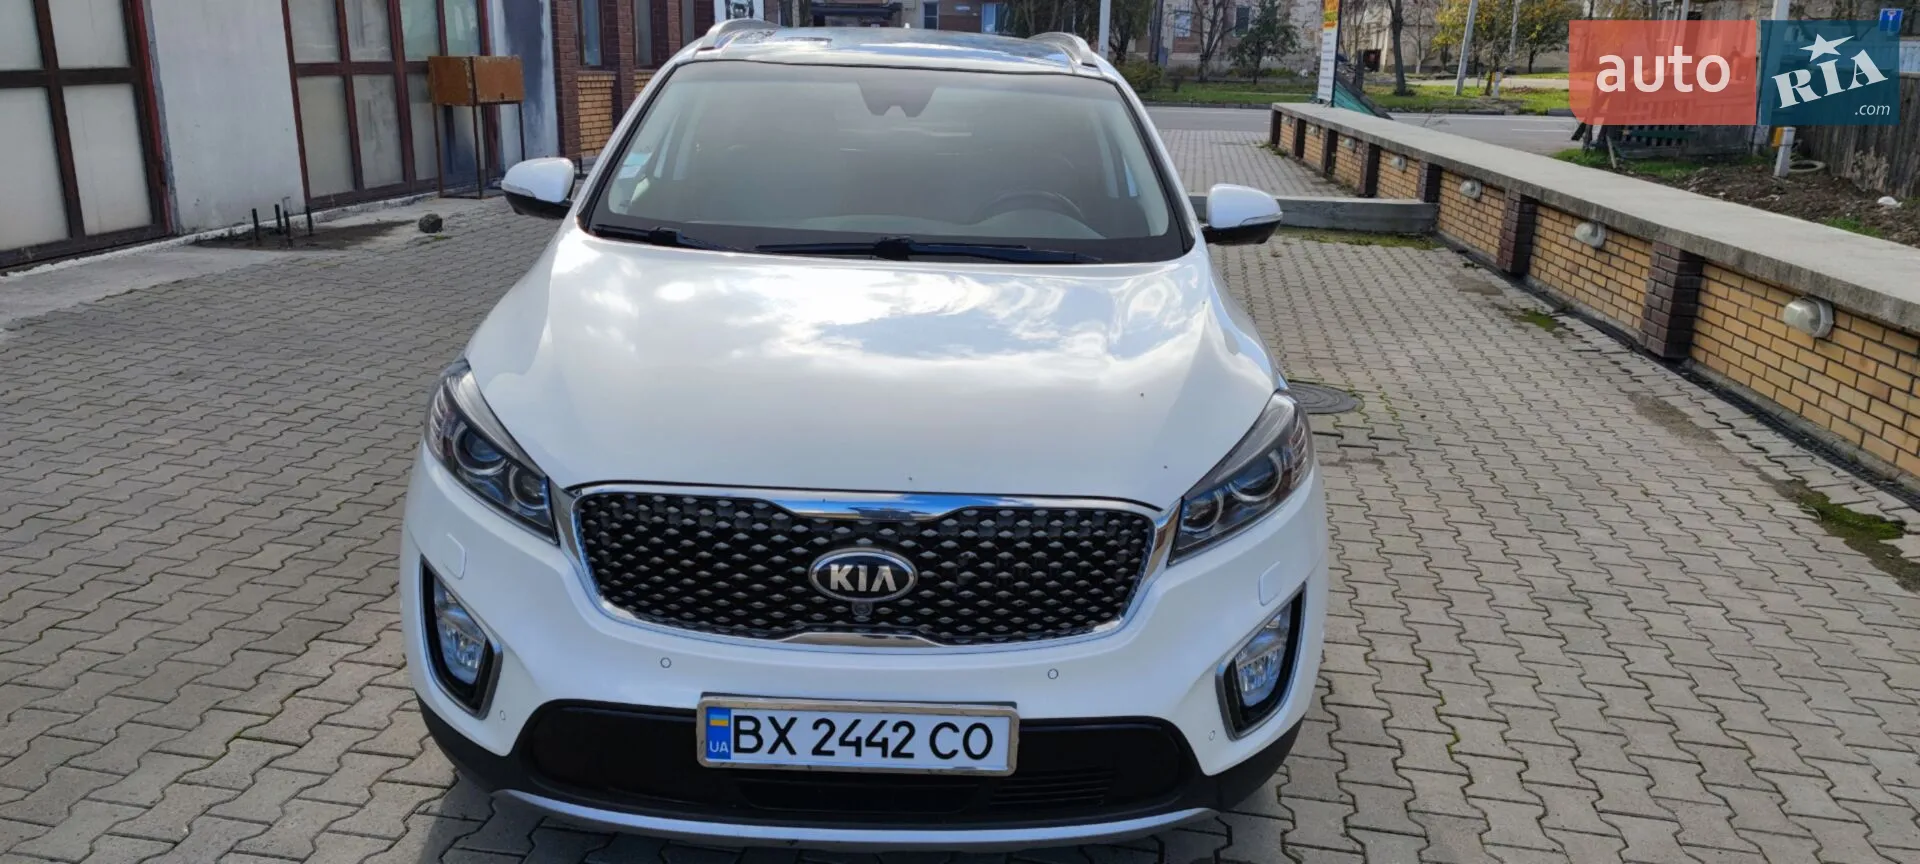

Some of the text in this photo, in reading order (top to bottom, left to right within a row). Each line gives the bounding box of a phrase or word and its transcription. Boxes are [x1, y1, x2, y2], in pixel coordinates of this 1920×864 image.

[829, 563, 897, 592] KIA
[709, 741, 729, 753] UA
[733, 714, 993, 760] BX 2442 CO
